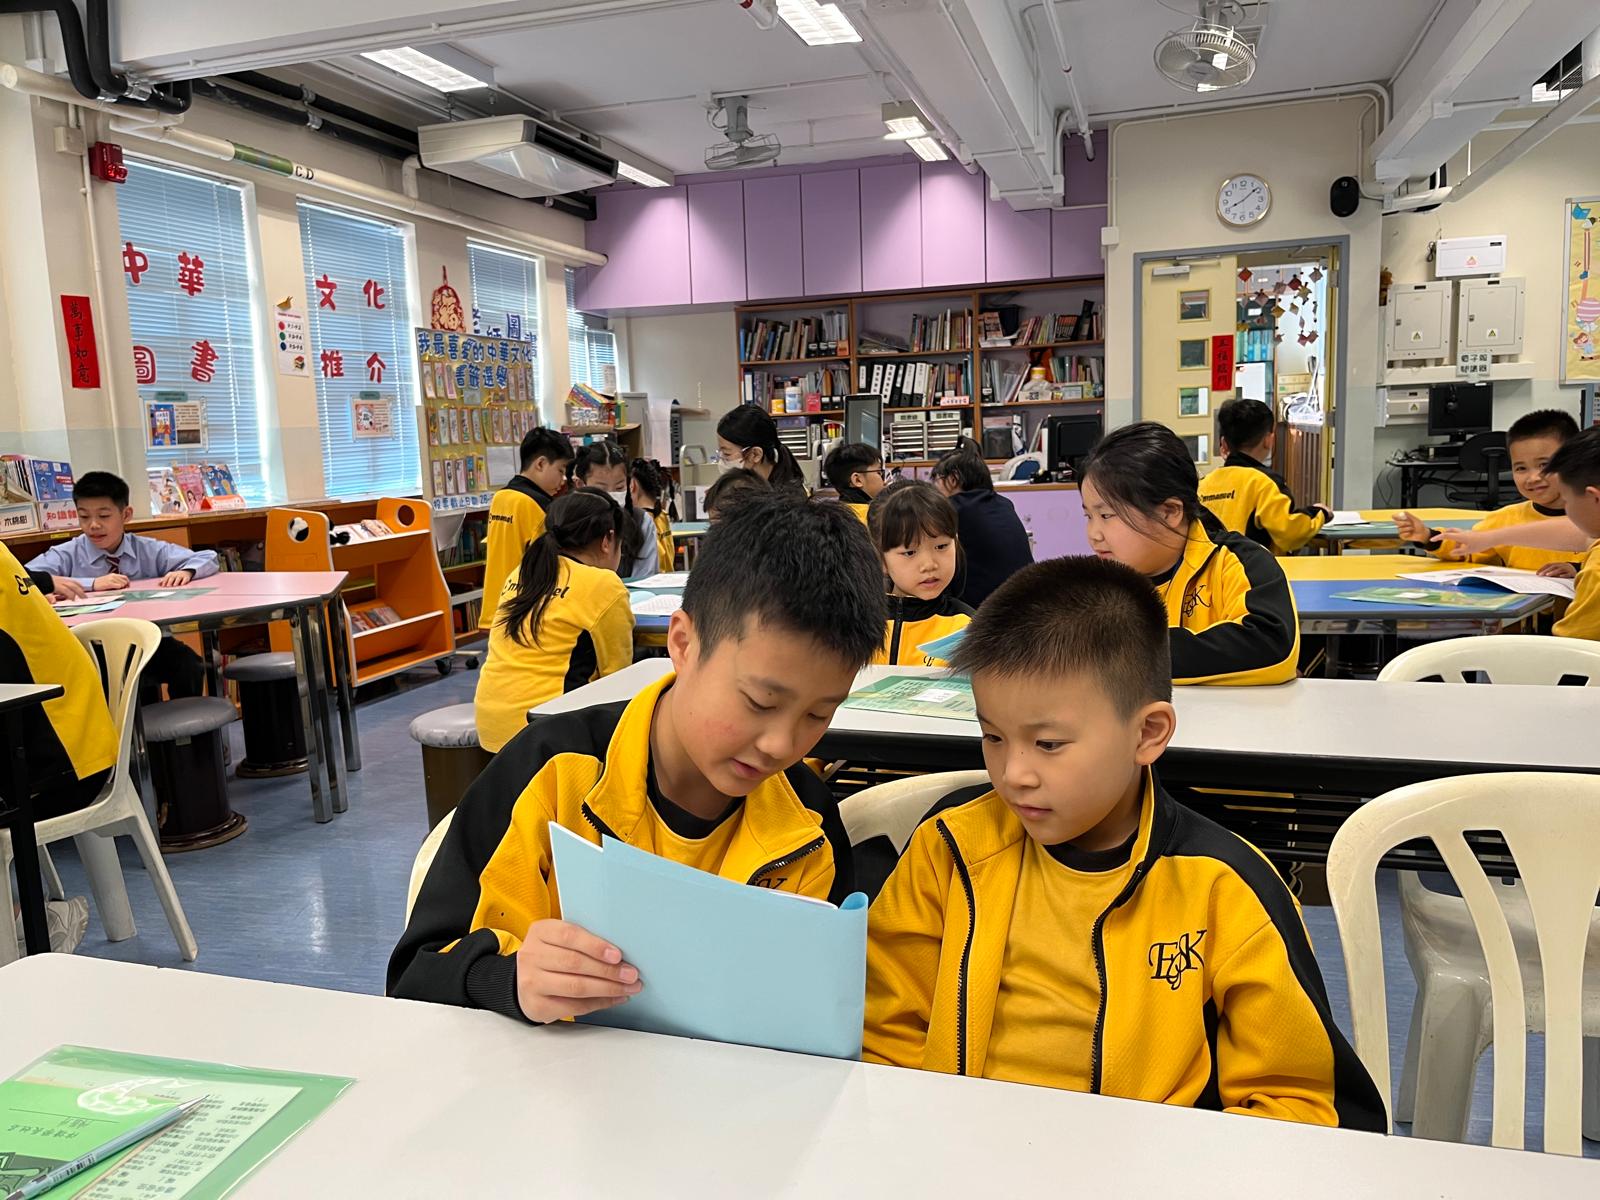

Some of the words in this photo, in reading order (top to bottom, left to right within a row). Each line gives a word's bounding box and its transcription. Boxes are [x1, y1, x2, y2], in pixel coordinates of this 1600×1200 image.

[315, 274, 385, 310] 文化
[70, 302, 90, 384] 萬事如意
[319, 349, 386, 383] 推介
